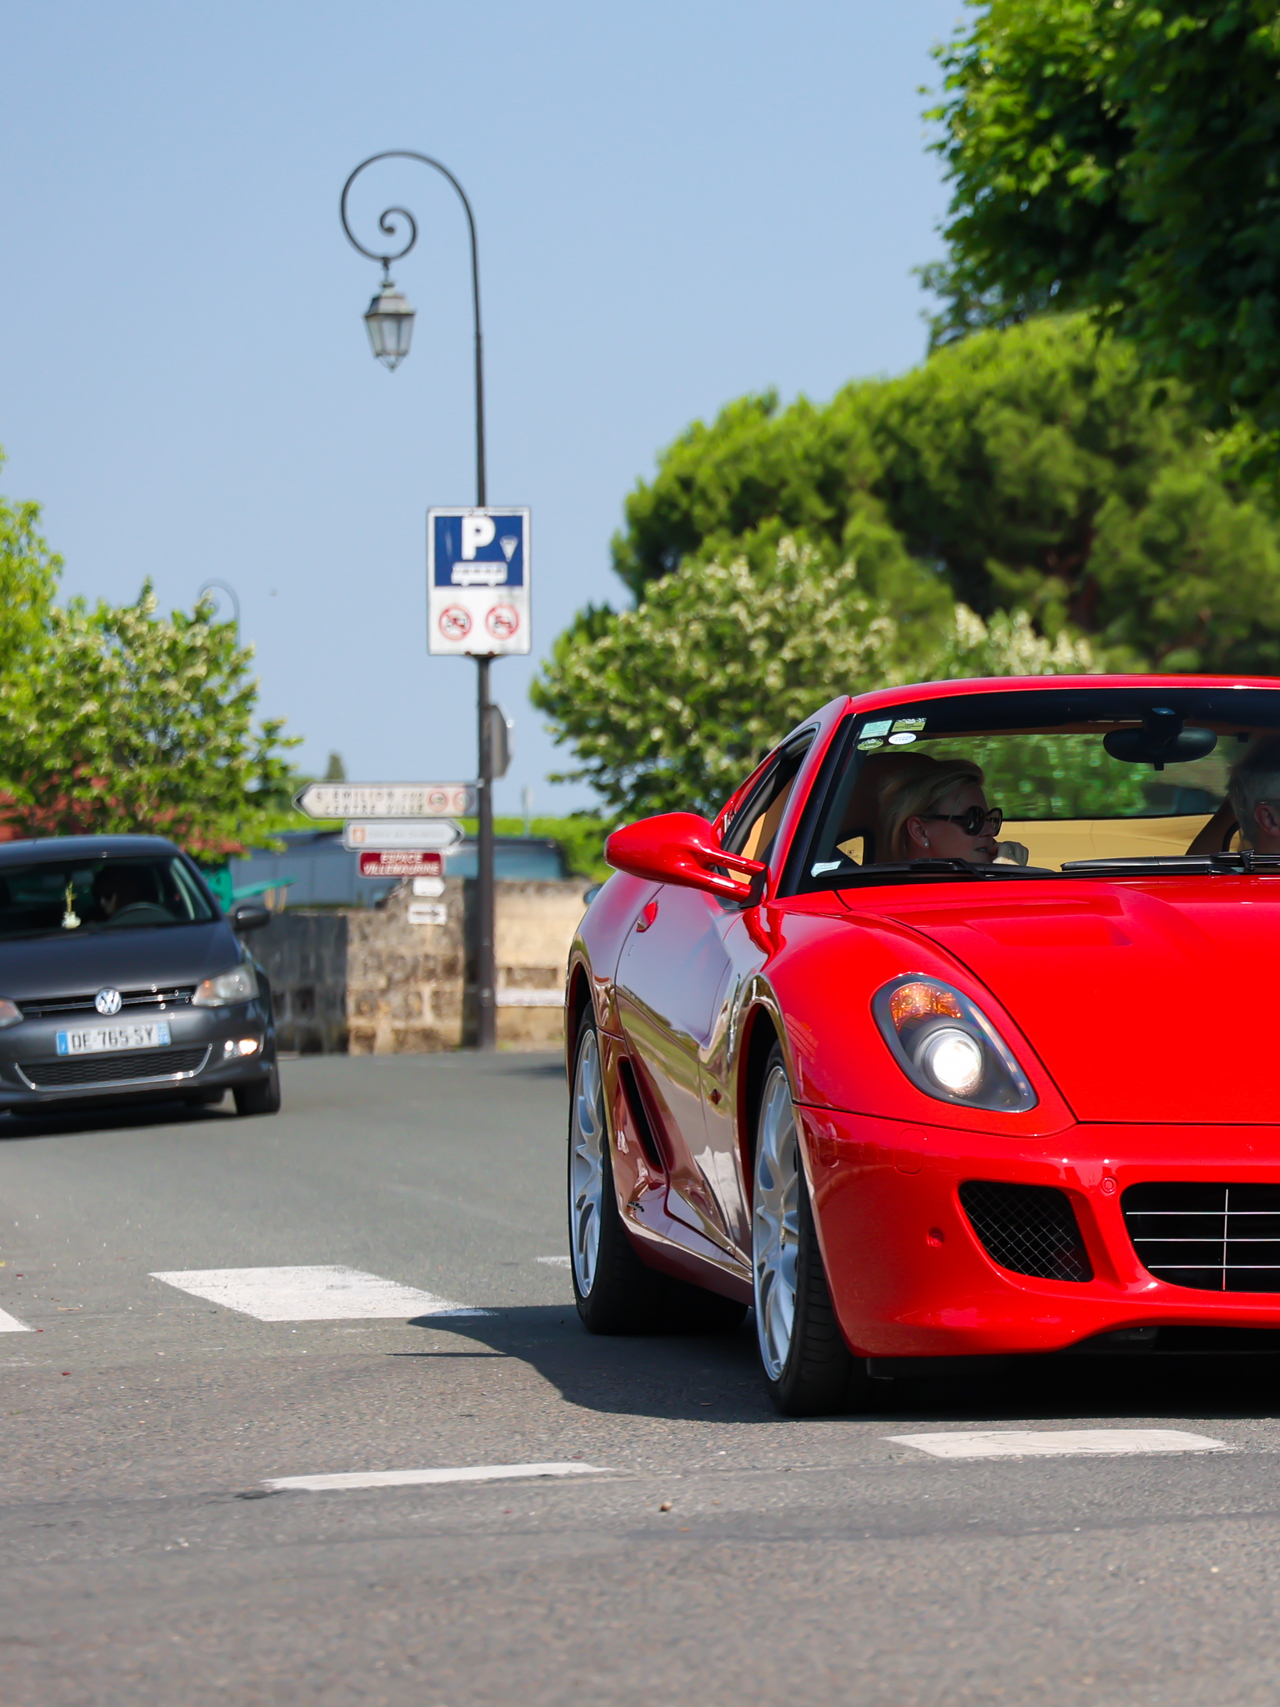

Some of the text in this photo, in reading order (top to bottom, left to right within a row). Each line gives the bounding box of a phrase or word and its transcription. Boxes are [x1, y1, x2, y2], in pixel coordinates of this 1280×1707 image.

[461, 515, 497, 561] P
[325, 803, 424, 816] CENTRE VILLE
[380, 853, 423, 863] ESPACE
[363, 863, 440, 875] VILLEMAURINE
